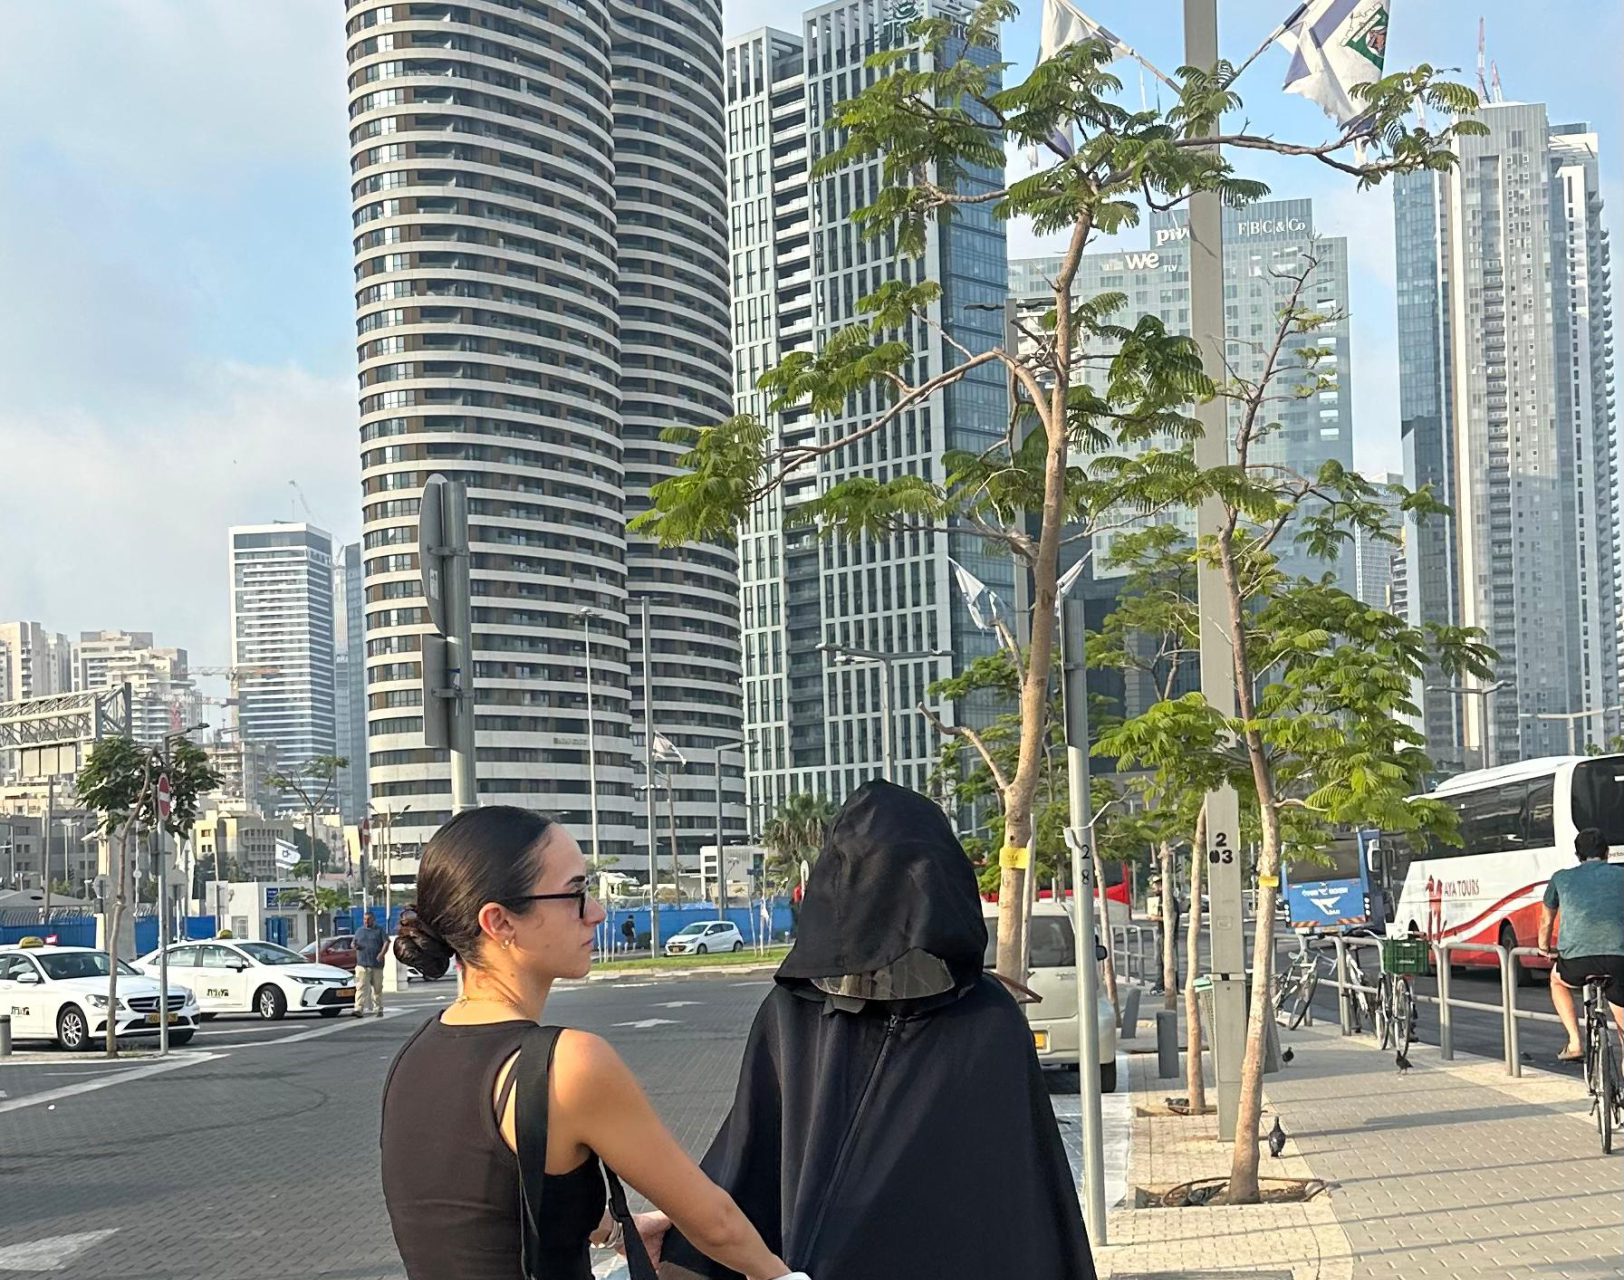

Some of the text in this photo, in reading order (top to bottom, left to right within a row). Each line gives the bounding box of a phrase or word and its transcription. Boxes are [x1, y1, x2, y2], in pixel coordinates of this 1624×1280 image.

[1125, 252, 1178, 272] we TLV
[1216, 832, 1227, 847] 2
[1081, 844, 1090, 859] 2
[1081, 869, 1090, 885] 8
[1457, 879, 1479, 897] TOURS
